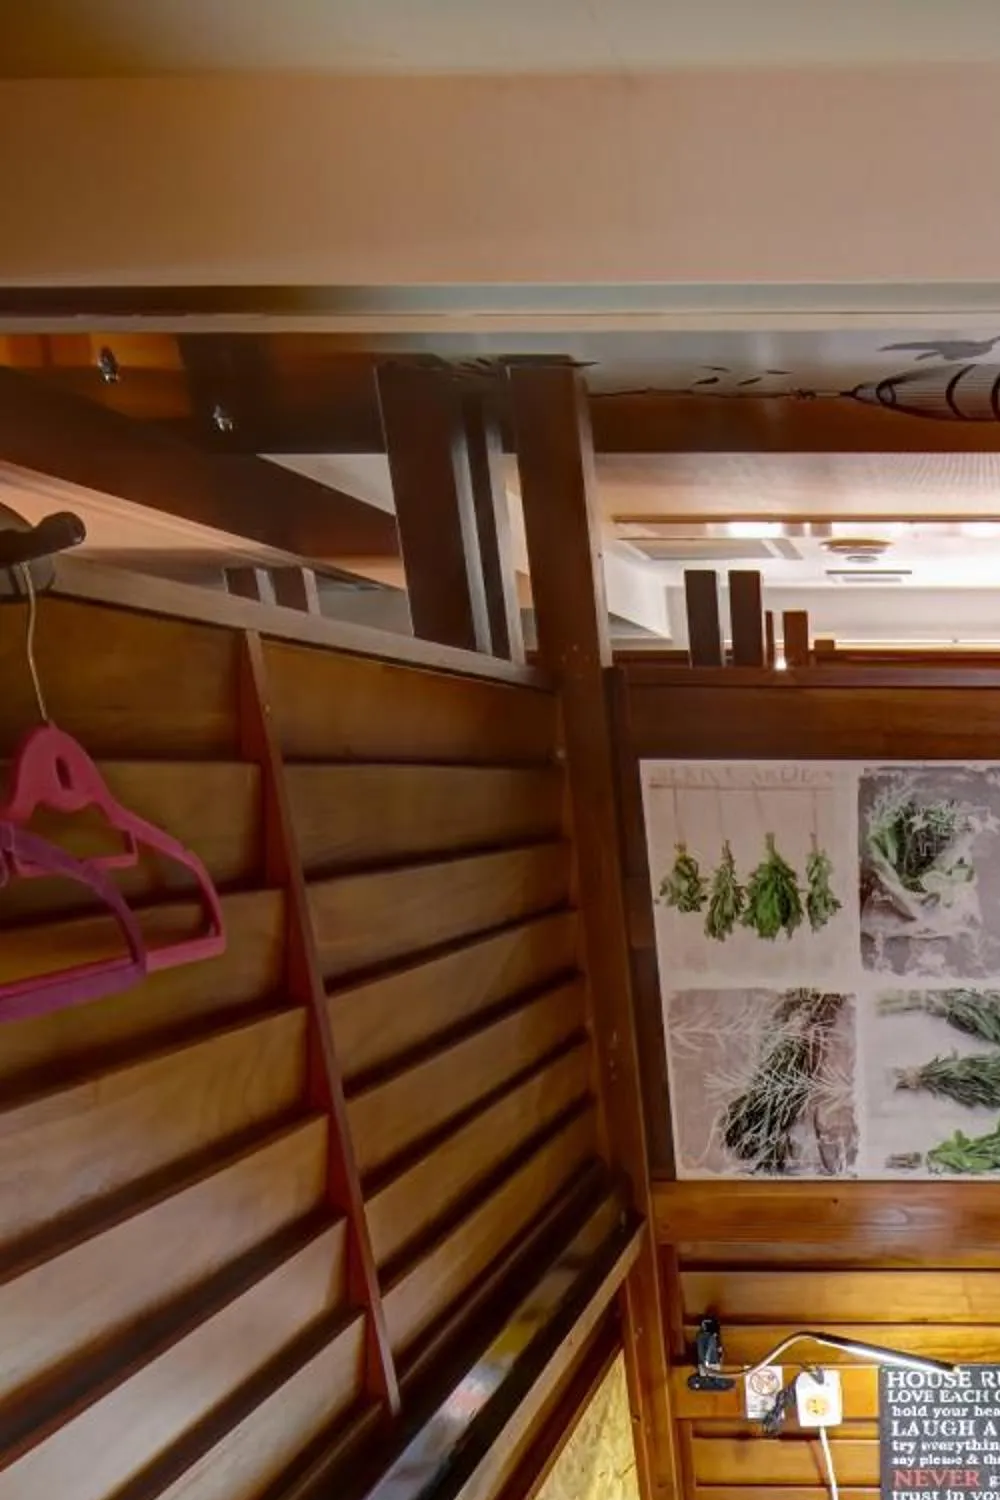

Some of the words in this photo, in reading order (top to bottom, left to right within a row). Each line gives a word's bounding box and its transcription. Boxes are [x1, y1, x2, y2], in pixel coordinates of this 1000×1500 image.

[887, 1370, 972, 1388] HOUSE
[887, 1389, 934, 1403] LOVE
[939, 1389, 989, 1403] EACH
[891, 1406, 927, 1417] hold
[933, 1407, 968, 1418] your
[891, 1419, 975, 1437] LAUGH
[983, 1420, 997, 1437] A
[891, 1439, 917, 1454] try
[966, 1454, 979, 1465] &
[893, 1469, 980, 1488] NEVER
